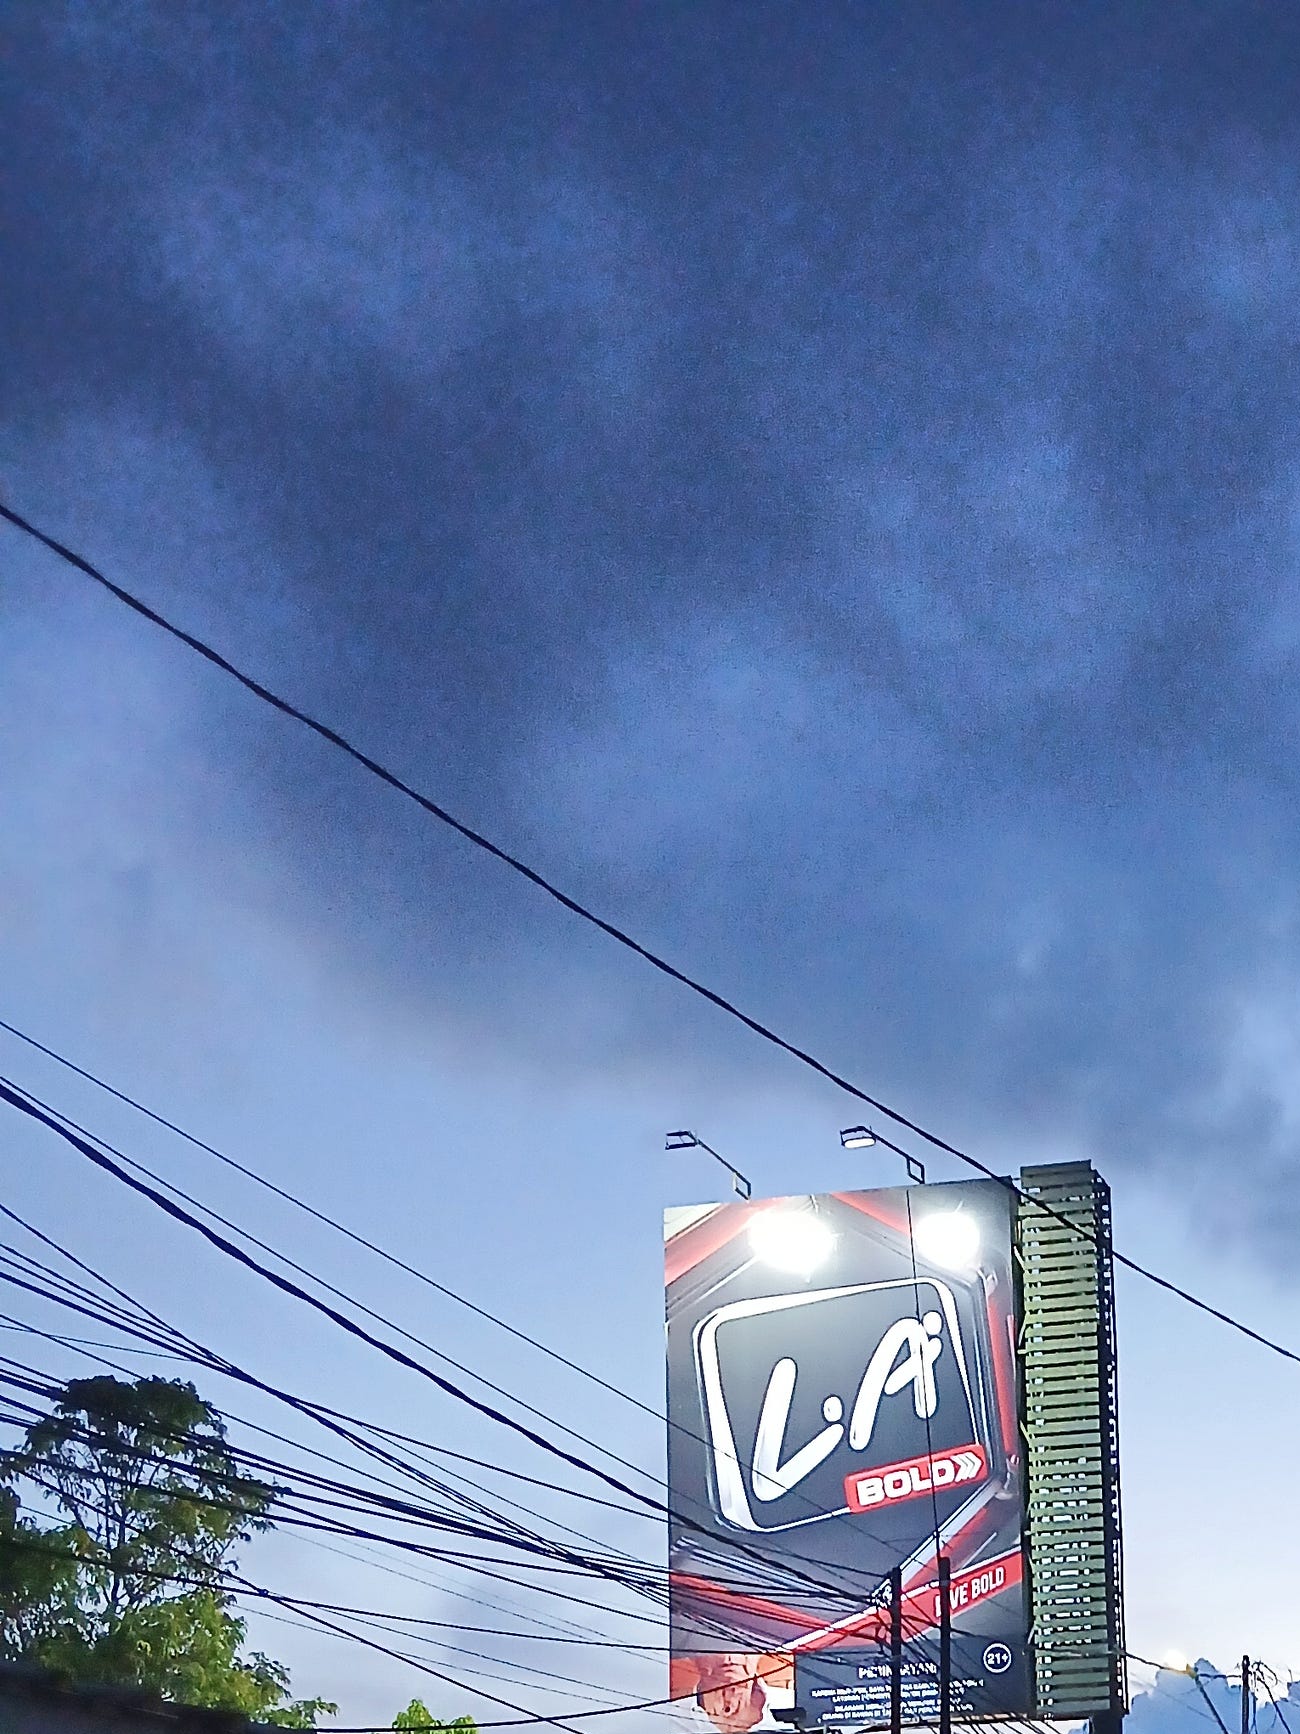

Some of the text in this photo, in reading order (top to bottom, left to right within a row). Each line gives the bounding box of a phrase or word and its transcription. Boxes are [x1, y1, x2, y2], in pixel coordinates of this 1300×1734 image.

[856, 1459, 955, 1506] BOLD
[971, 1566, 1005, 1599] BOLD
[986, 1652, 1009, 1665] 21+
